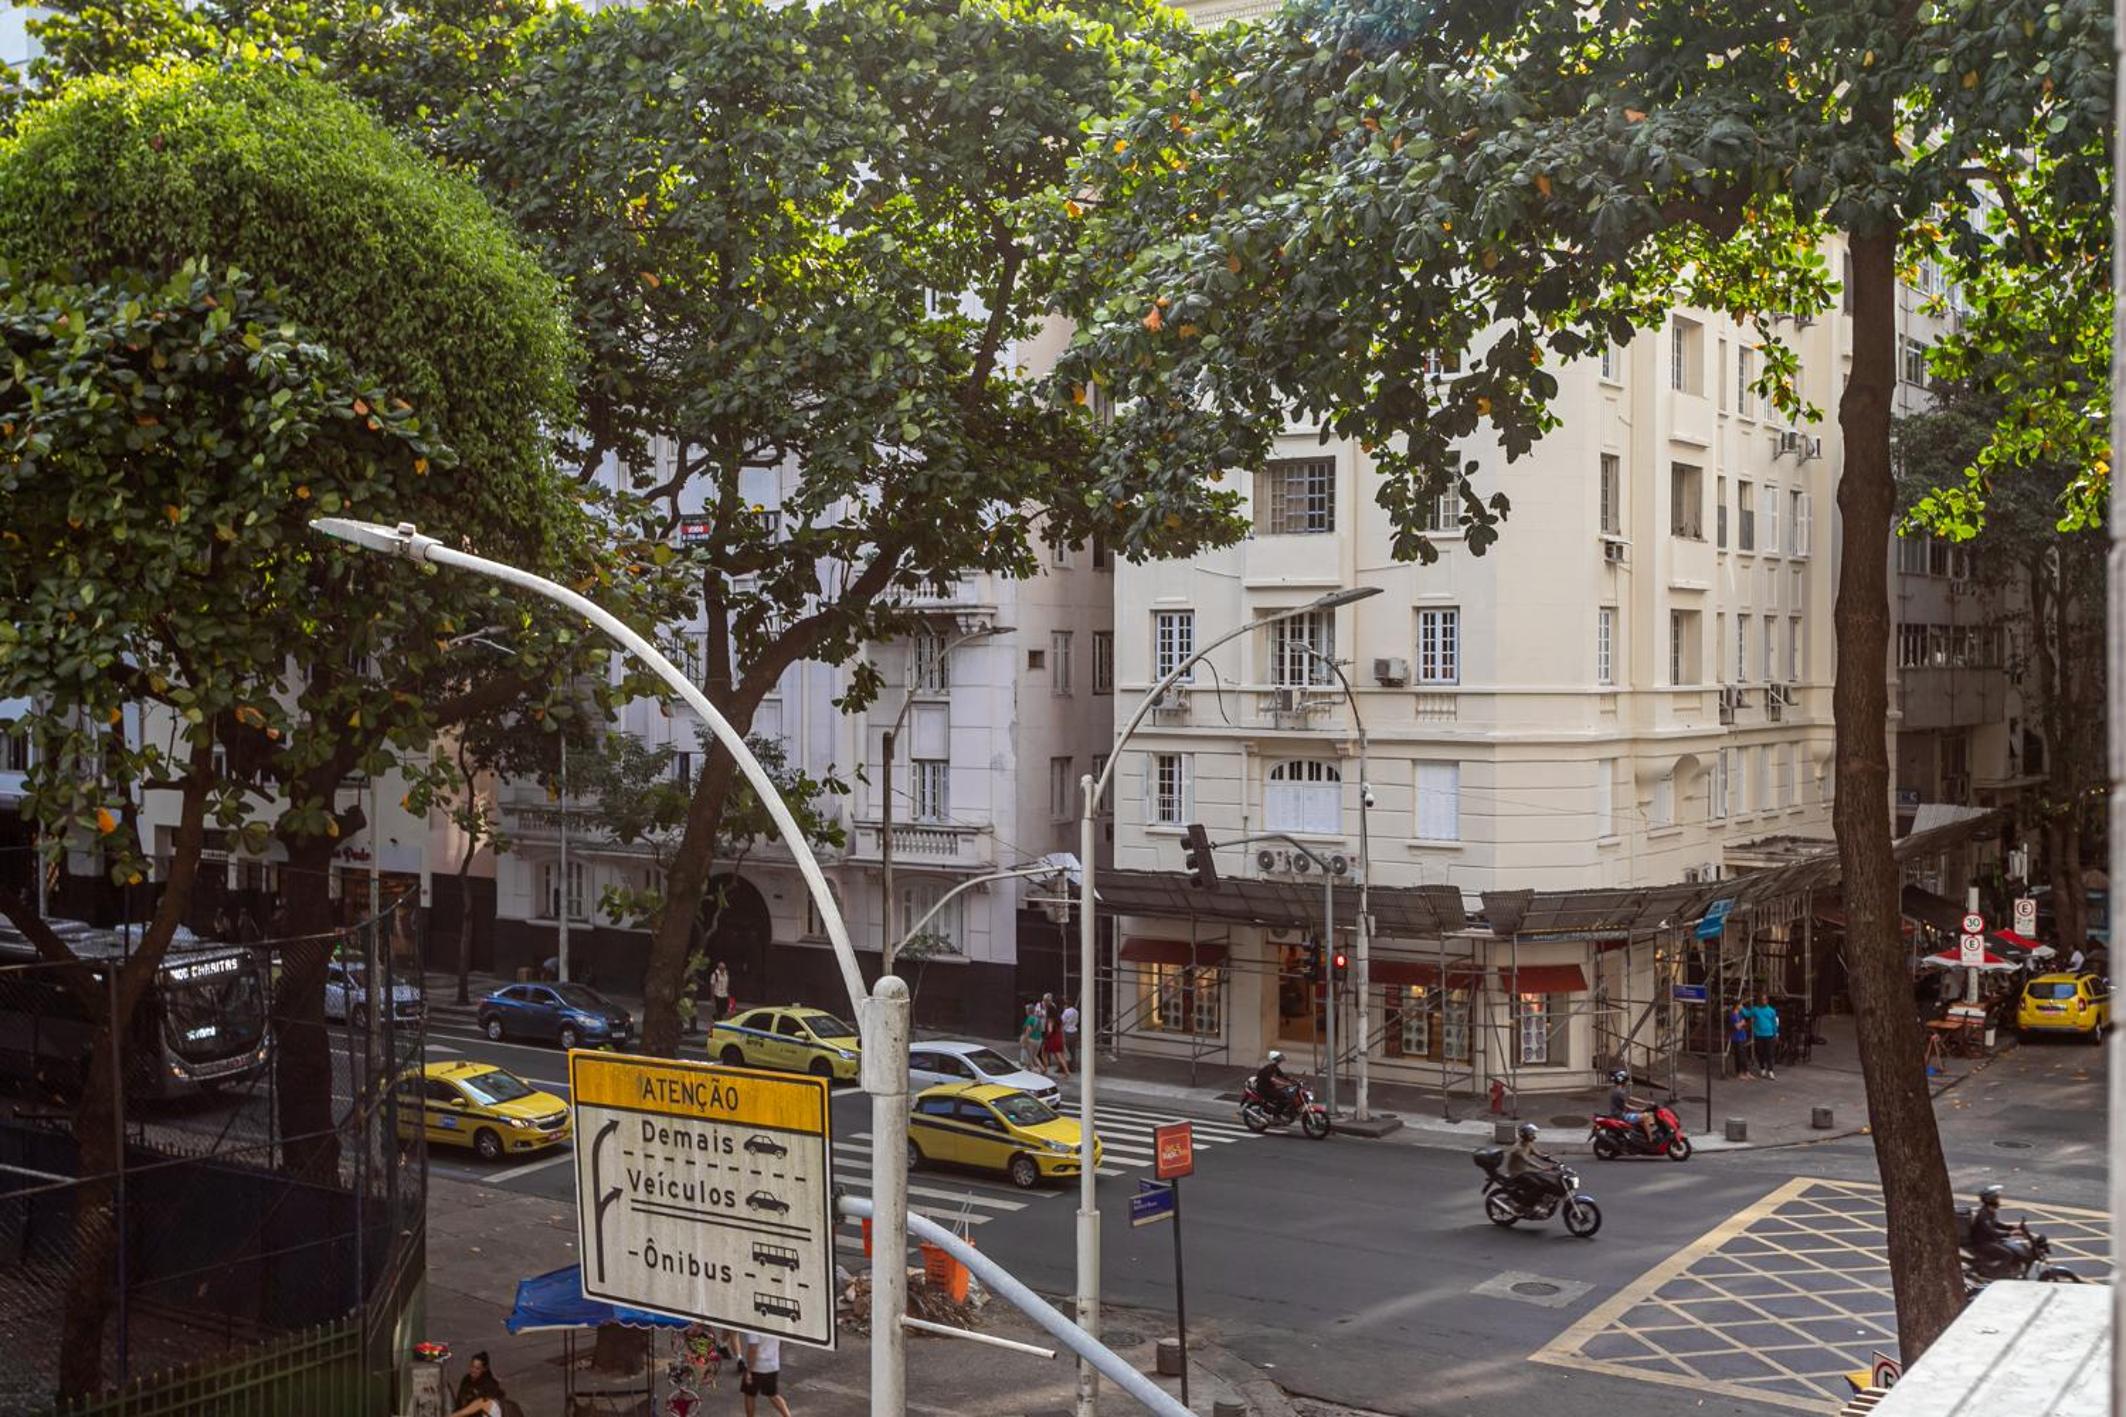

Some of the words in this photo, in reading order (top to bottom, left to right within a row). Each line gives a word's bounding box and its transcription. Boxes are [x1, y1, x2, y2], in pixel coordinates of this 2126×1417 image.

[1966, 918, 1980, 927] 30
[642, 1077, 738, 1112] ATENÇÃO
[642, 1119, 734, 1155] Demais
[626, 1167, 737, 1208] Veículos
